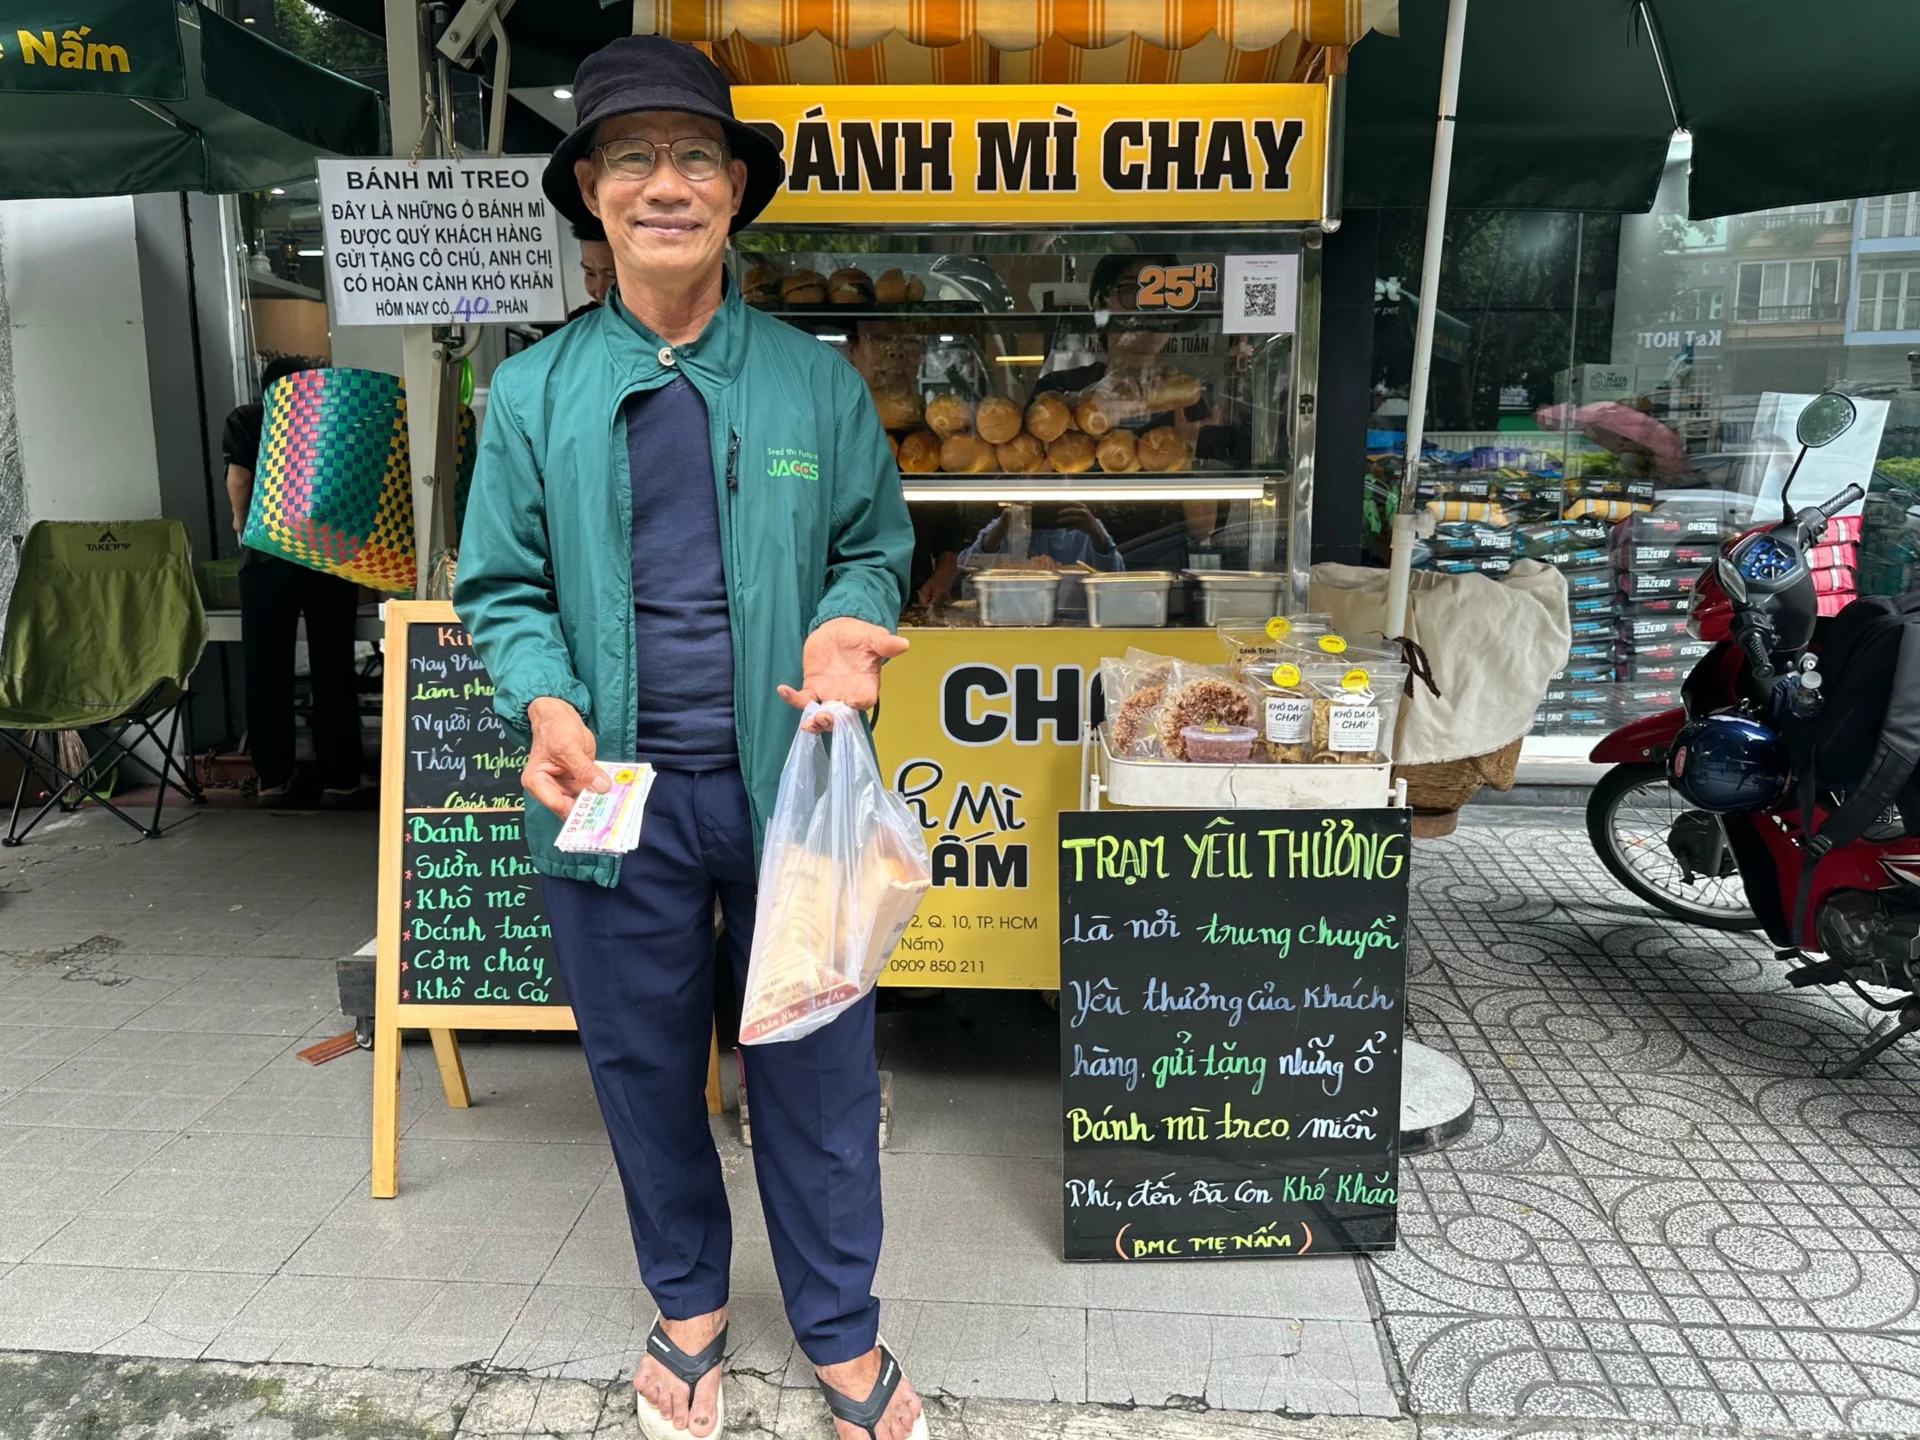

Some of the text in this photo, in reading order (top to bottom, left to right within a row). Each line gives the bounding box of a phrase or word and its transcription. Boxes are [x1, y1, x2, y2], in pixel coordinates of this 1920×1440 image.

[17, 26, 131, 73] Nấm
[975, 104, 1078, 192] MÌ
[1102, 120, 1305, 191] CHAY
[347, 166, 529, 189] BÁNH MÌ TREO
[332, 200, 366, 220] ĐÂY
[371, 200, 393, 220] LÀ
[397, 200, 457, 219] NHỮNG
[478, 199, 523, 218] BÁNH
[528, 198, 545, 218] MÌ
[340, 223, 542, 249] ĐƯỢC QUÝ KHÁCH HÀNG
[335, 247, 552, 272] GỬI TẶNG CÔ CHÚ, ANH CHỊ
[343, 272, 553, 292] CÓ HOÀN CẢNH KHÓ KHĂN
[376, 299, 403, 316] HÔM
[407, 301, 429, 316] NAY
[455, 296, 489, 322] 40
[767, 448, 818, 459] Seed the Future
[767, 459, 819, 480] JACCS
[410, 656, 447, 679] Nay
[1275, 713, 1302, 722] CHAY
[1341, 720, 1368, 729] CHAY
[410, 738, 466, 780] Thấy
[949, 786, 1026, 830] Mì
[408, 814, 522, 843] Bánh mì
[931, 832, 1028, 887] ẤM
[1062, 834, 1170, 885] TRẠM
[1183, 816, 1253, 879] YÊU
[416, 885, 533, 910] Khô mè
[411, 914, 552, 941] Bánh trán
[928, 915, 945, 929] Q.
[952, 915, 971, 930] 10,
[976, 915, 995, 929] TP.
[999, 915, 1038, 930] HCM
[1063, 913, 1114, 944] Là
[1196, 912, 1291, 959] trung
[901, 936, 944, 953] Nấm)
[484, 945, 545, 979] cháy
[890, 960, 984, 973] 0909 850 211
[416, 977, 553, 1003] Khô da Cá
[1069, 977, 1131, 1028] Yêu
[1152, 1031, 1197, 1089] gửi
[1198, 1041, 1267, 1095] tặng
[1066, 1104, 1155, 1142] Bánh
[1161, 1107, 1211, 1140] mì
[1298, 1107, 1378, 1140] miễn
[1065, 1178, 1122, 1210] Phí,
[1127, 1172, 1182, 1207] đến
[1234, 1180, 1273, 1203] Con
[1283, 1168, 1329, 1202] Khó
[1335, 1171, 1398, 1204] Khăn
[1188, 1238, 1226, 1250] MẸ
